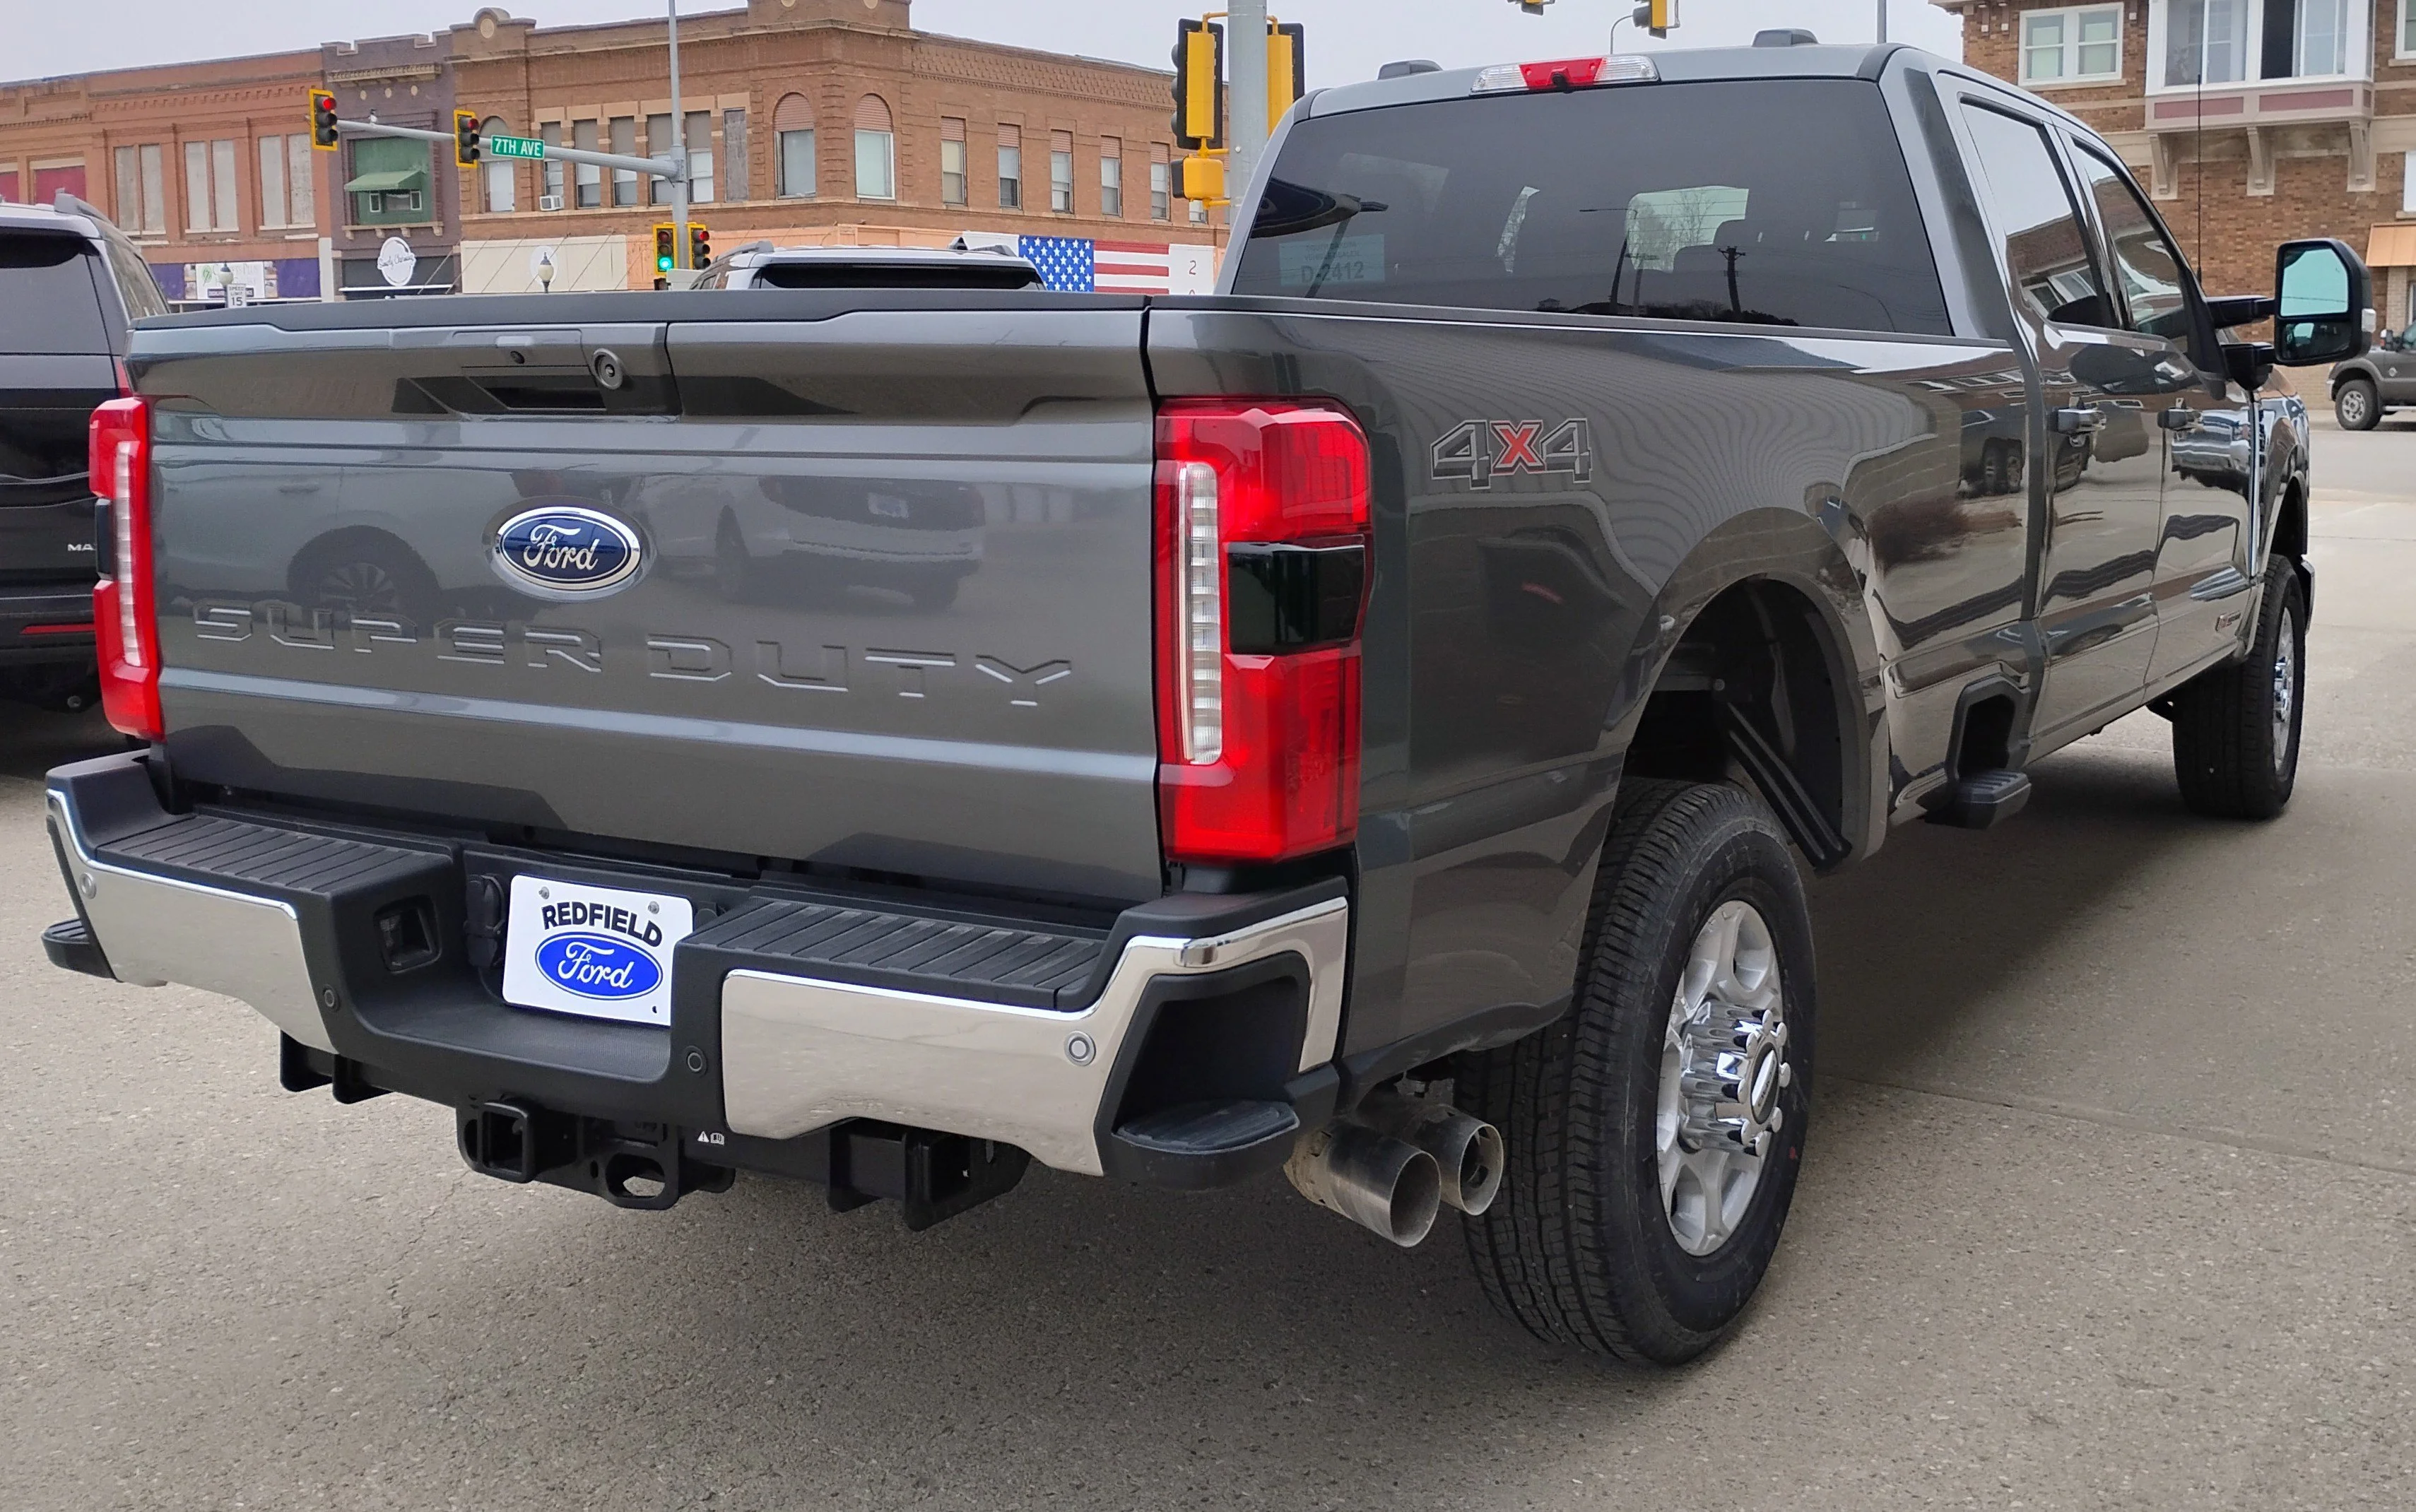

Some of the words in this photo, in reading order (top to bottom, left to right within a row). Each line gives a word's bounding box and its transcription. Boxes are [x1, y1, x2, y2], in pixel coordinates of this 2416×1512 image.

[495, 138, 517, 154] 7TH
[520, 141, 541, 156] AVE
[1189, 260, 1196, 275] 2
[1301, 261, 1365, 283] D-2412
[231, 297, 243, 306] 15
[523, 524, 600, 570] Ford
[194, 599, 603, 672] SUPER
[647, 633, 1071, 706] DUTY
[541, 901, 663, 947] REDFIELD
[558, 941, 635, 988] Ford
